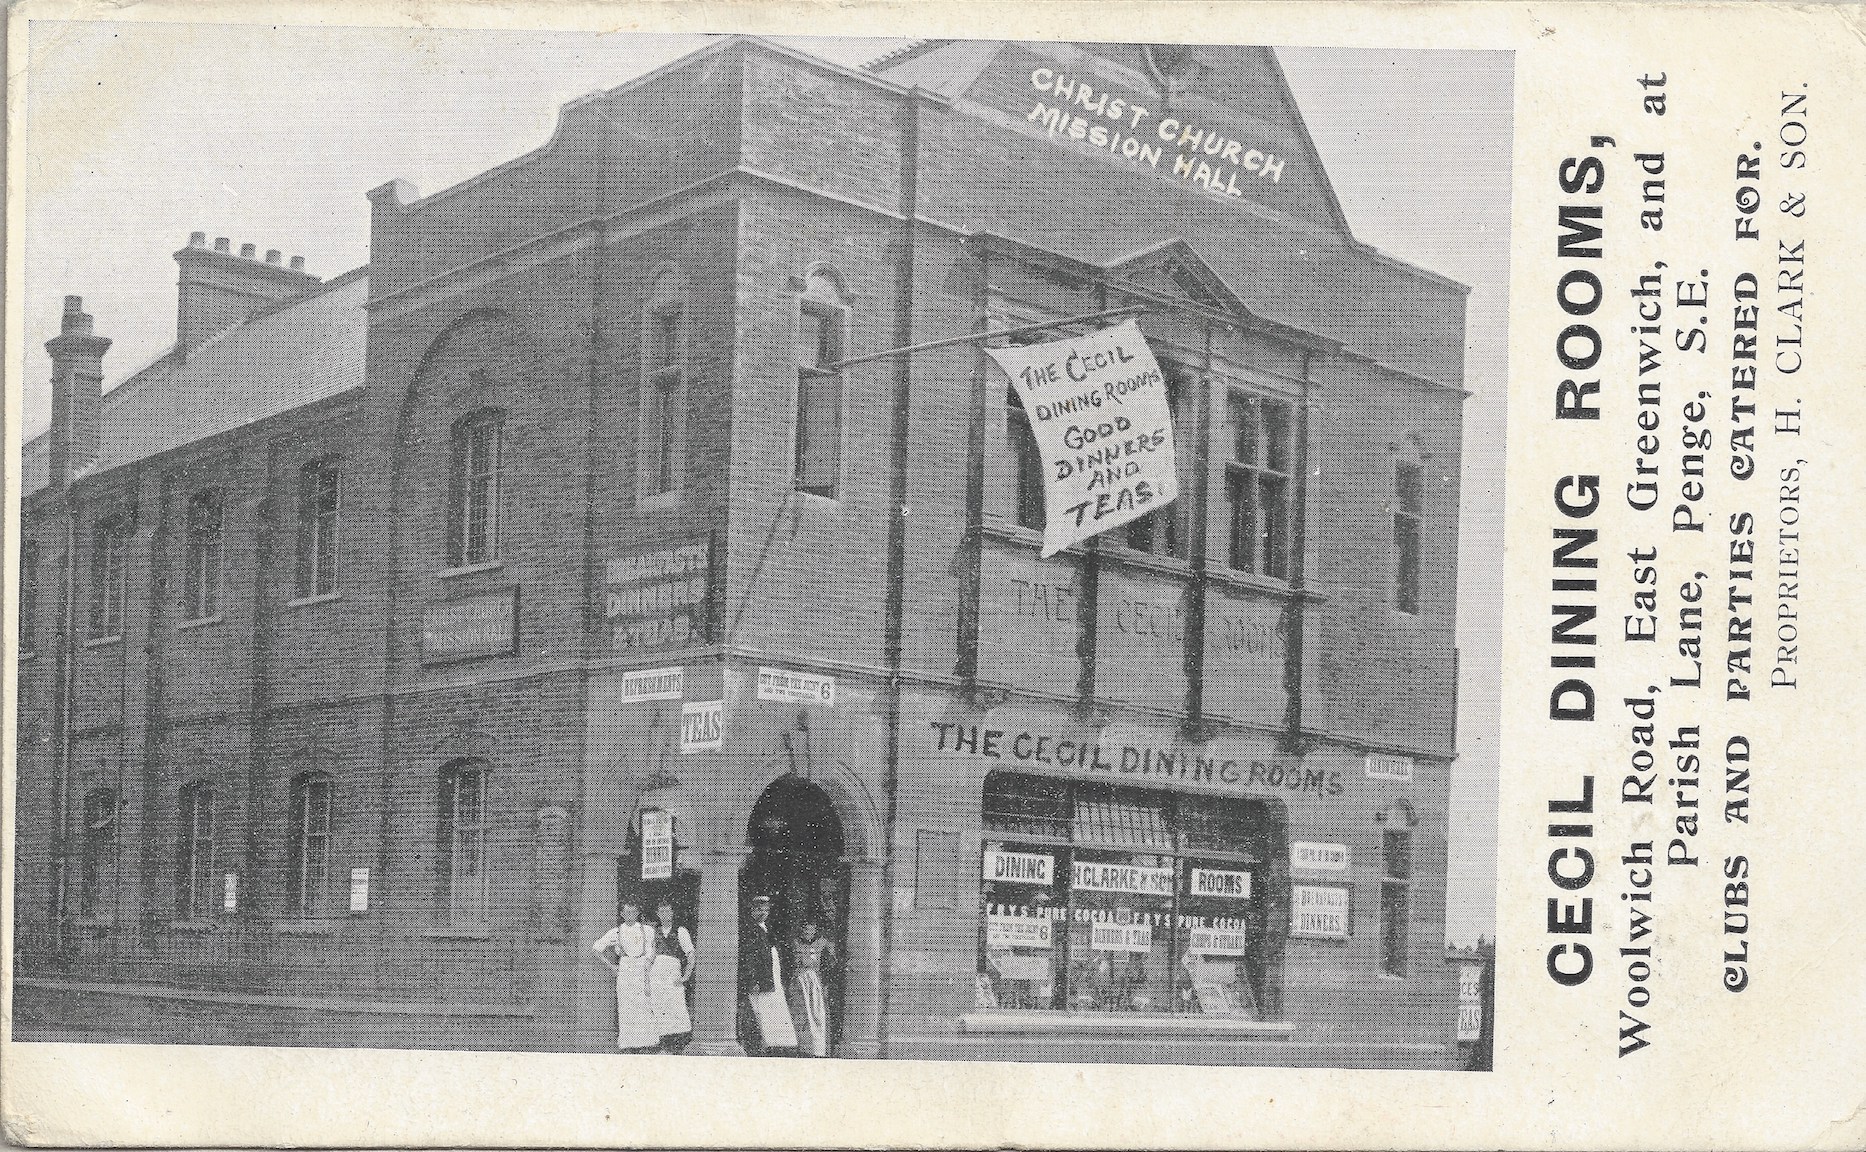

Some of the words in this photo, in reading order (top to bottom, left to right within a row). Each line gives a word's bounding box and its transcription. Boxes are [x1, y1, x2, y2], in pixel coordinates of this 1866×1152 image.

[1031, 68, 1149, 129] CHRIST
[1158, 118, 1285, 183] CHURCH
[1027, 102, 1162, 168] MISSION
[1173, 153, 1242, 197] HALL
[1019, 362, 1061, 391] THE
[1065, 346, 1134, 383] CECIL
[1035, 389, 1102, 421] DINING
[1103, 368, 1162, 405] ROOMS
[1063, 416, 1131, 451] GOOD
[1053, 428, 1166, 483] DINNERS
[1087, 461, 1142, 491] AND
[606, 577, 706, 618] DINNERS
[1010, 578, 1075, 621] THE
[623, 674, 682, 697] REFRESHMENTS
[820, 682, 831, 700] 6
[681, 710, 721, 744] TEAS
[930, 721, 1004, 759] THE
[1013, 731, 1111, 773] CECIL
[1118, 746, 1241, 784] DINING
[1243, 760, 1345, 798] ROOMS
[995, 854, 1046, 880] DINING
[1083, 865, 1139, 889] CLARKE
[1199, 871, 1242, 895] ROOMS
[1036, 906, 1068, 921] PURE
[1074, 908, 1114, 924] COCOA
[1178, 915, 1206, 929] PURE
[1212, 917, 1246, 930] COCOA
